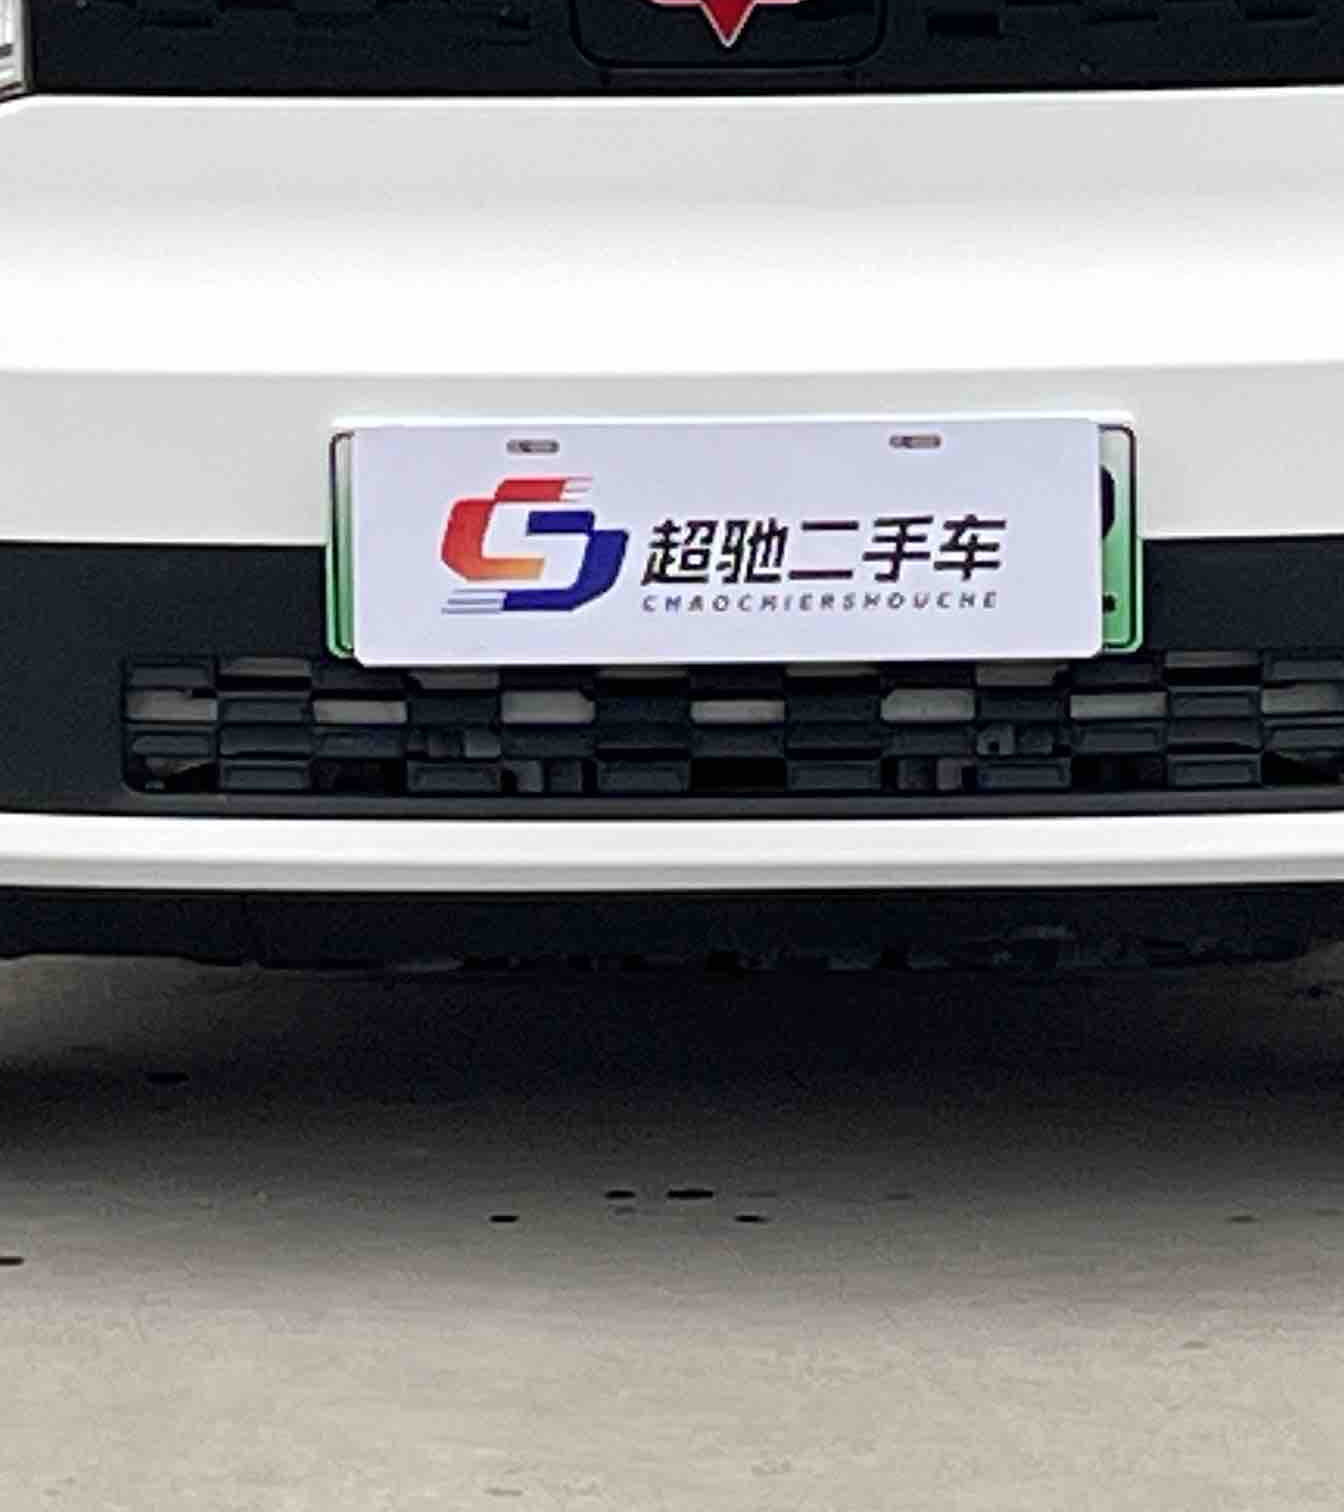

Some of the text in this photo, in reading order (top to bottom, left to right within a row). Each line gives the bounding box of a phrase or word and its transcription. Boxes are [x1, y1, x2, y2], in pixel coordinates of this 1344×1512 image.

[640, 514, 1007, 586] 超驰二手车
